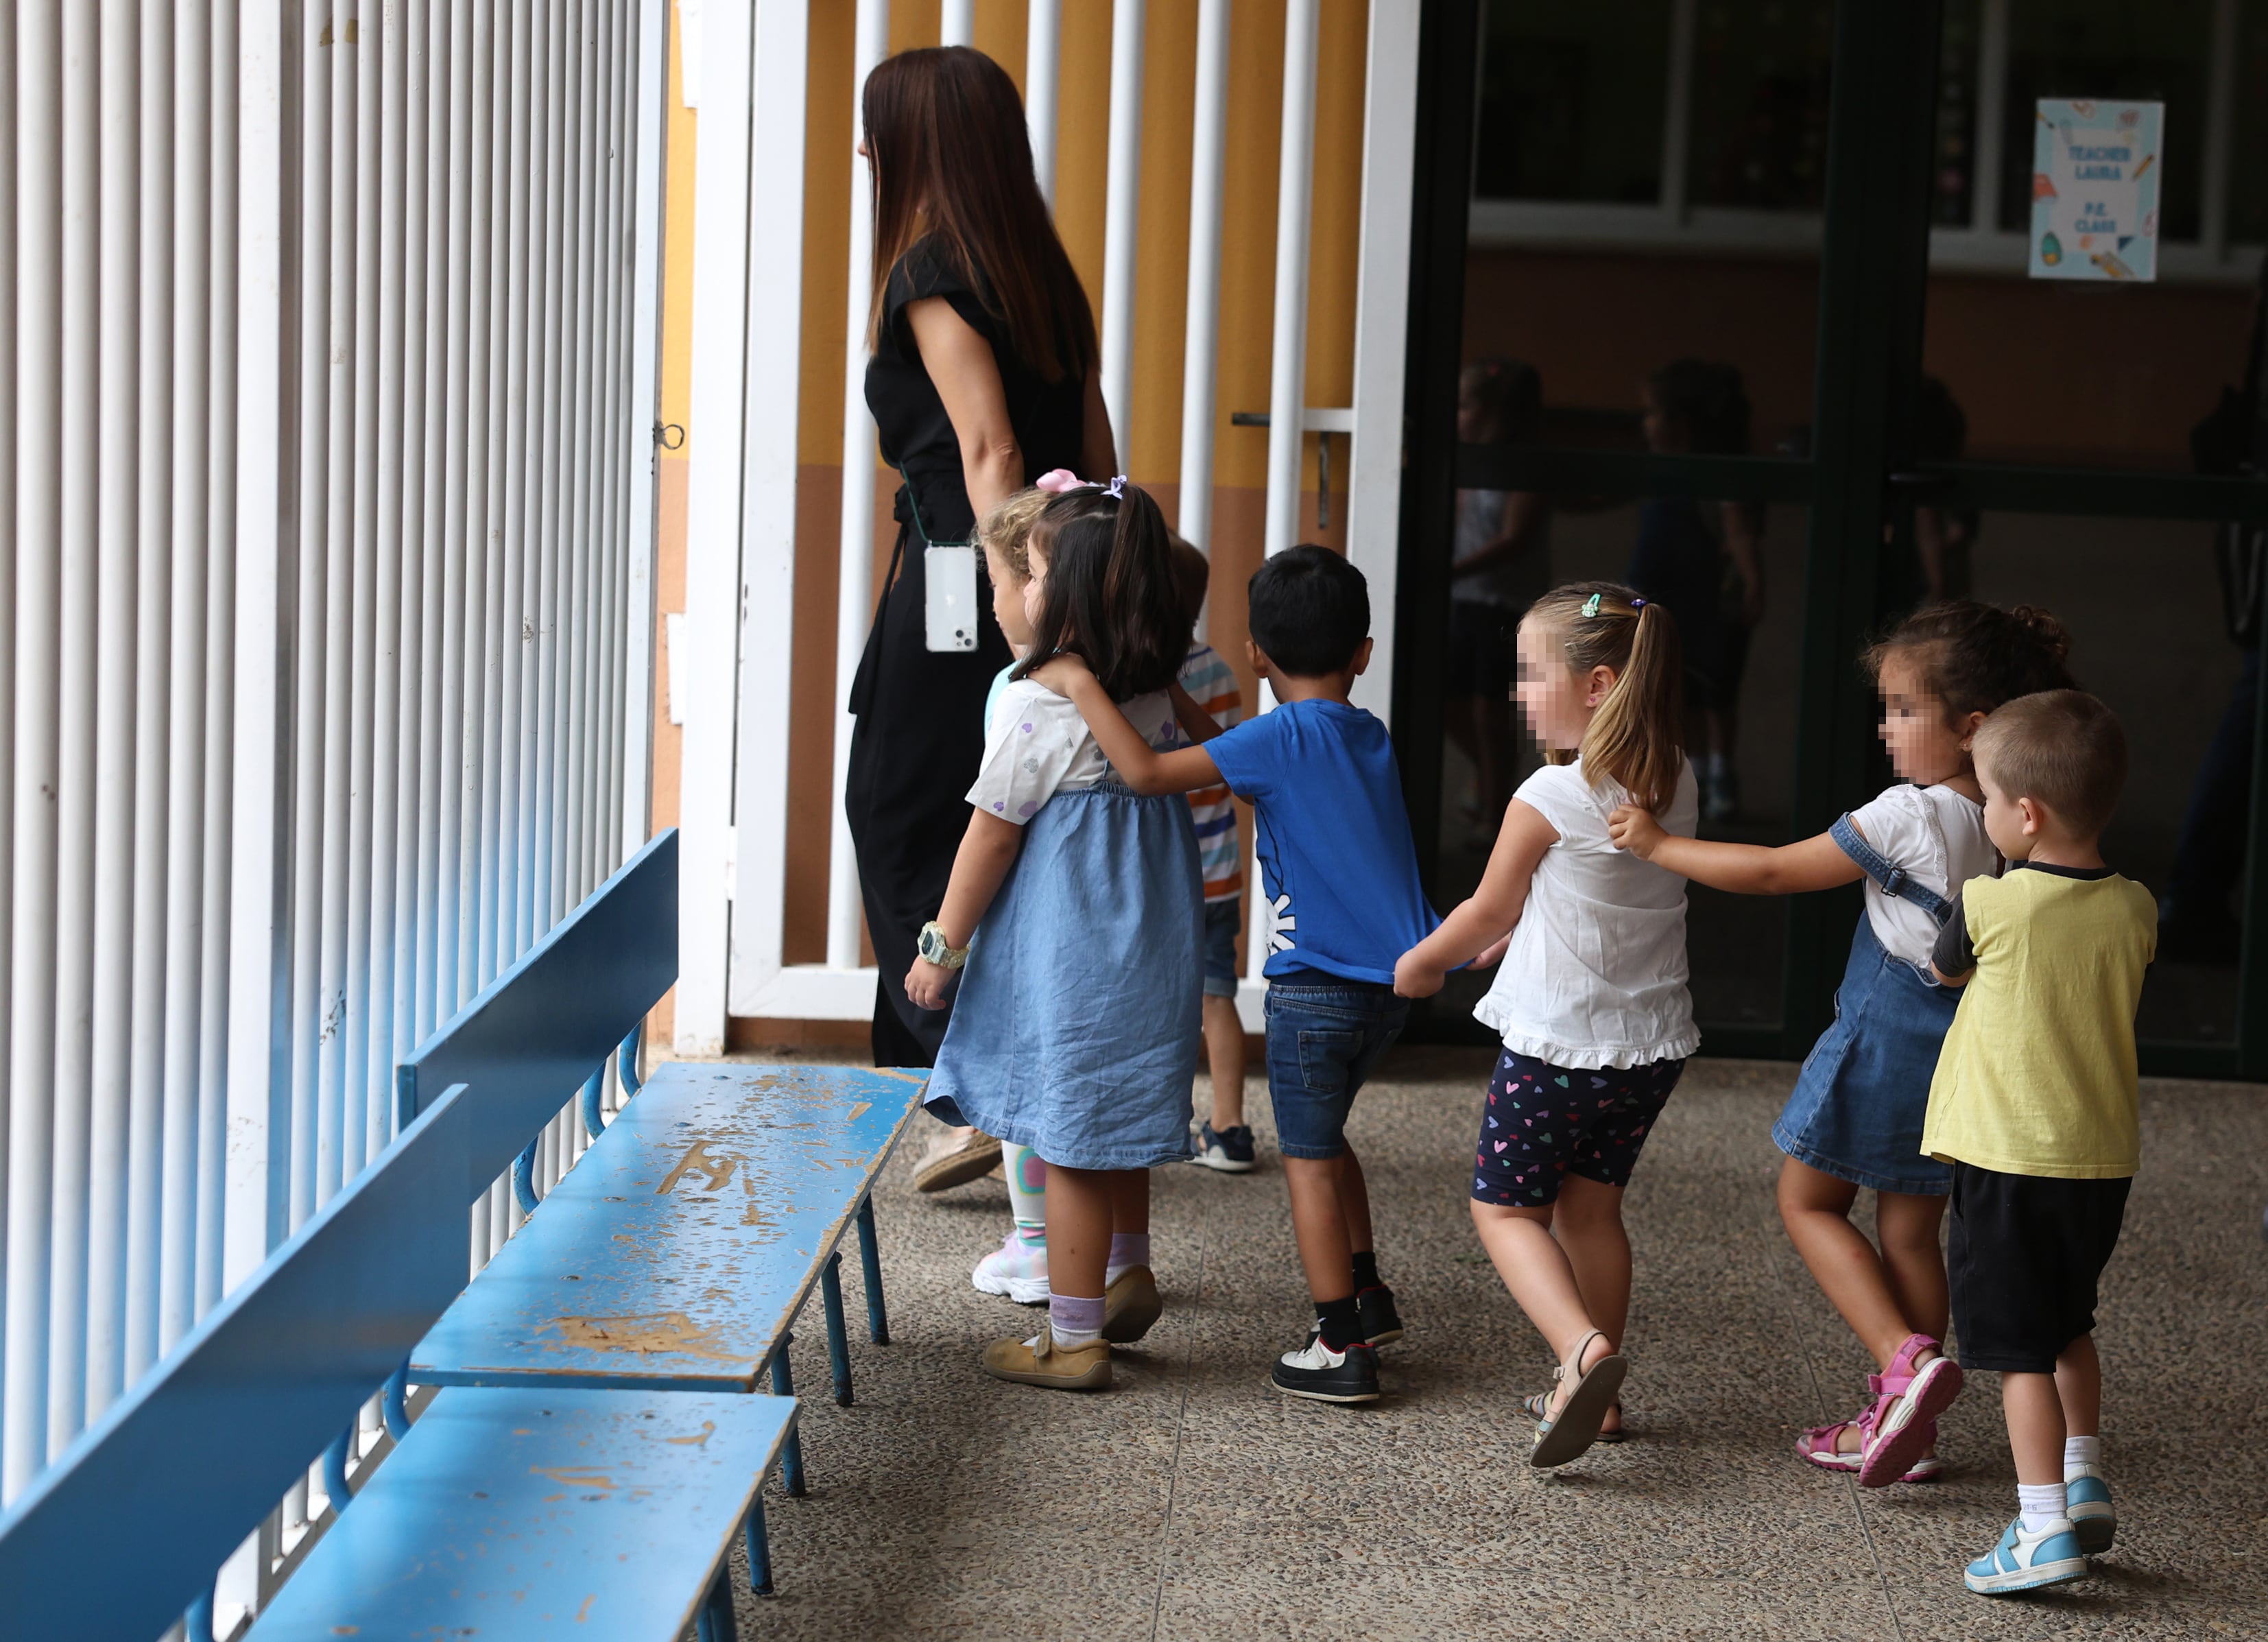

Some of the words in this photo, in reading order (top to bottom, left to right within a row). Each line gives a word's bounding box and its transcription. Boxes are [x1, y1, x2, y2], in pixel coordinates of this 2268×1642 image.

[2068, 145, 2131, 161] TEACHER
[2075, 165, 2121, 180] LAURA
[2074, 218, 2116, 233] CLASS
